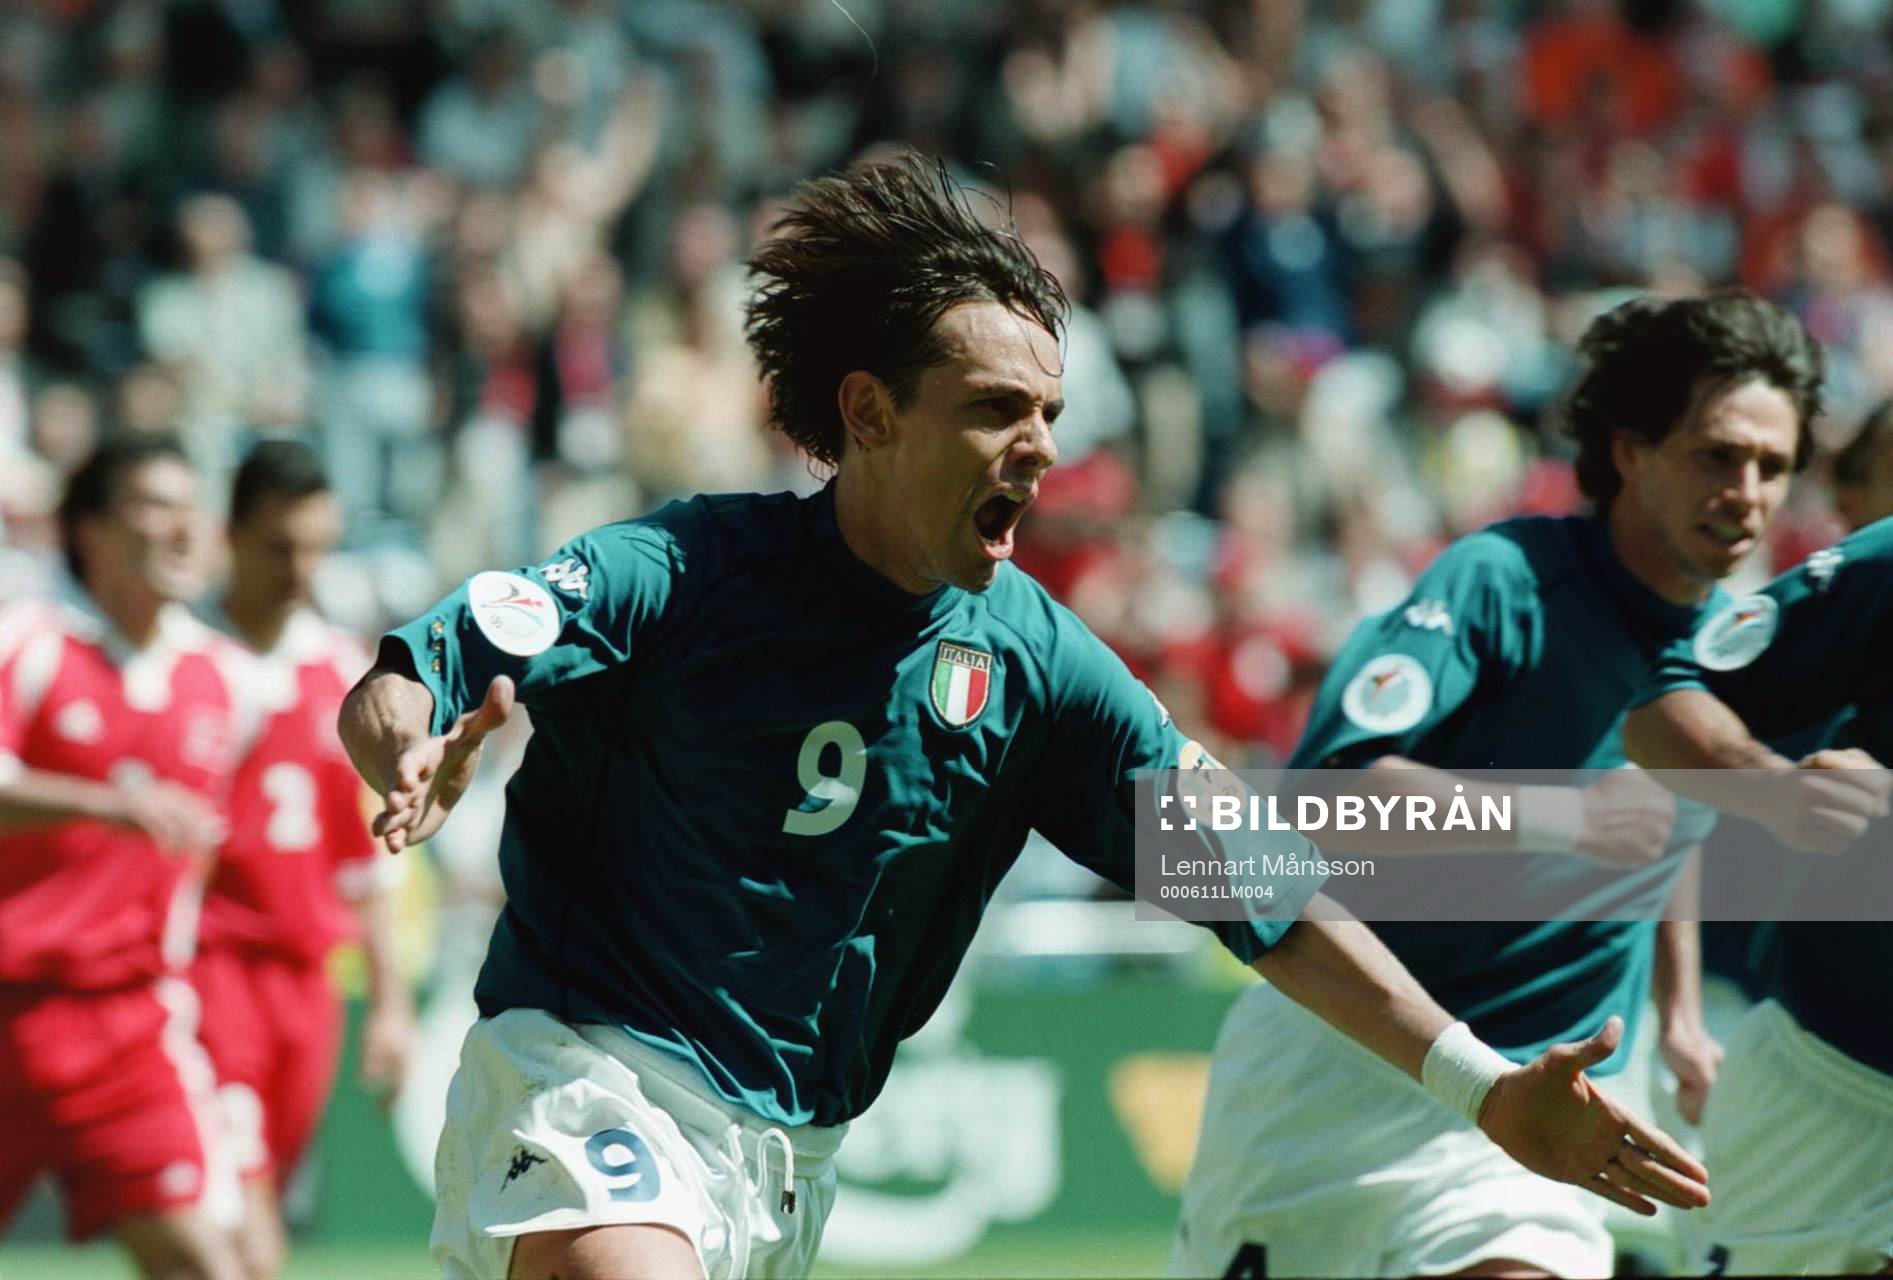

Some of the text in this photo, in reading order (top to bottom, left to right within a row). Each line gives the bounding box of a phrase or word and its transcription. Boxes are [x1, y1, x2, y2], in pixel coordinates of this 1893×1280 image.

[942, 647, 986, 669] ITALIA
[782, 720, 867, 836] 9
[584, 1128, 661, 1202] 9
